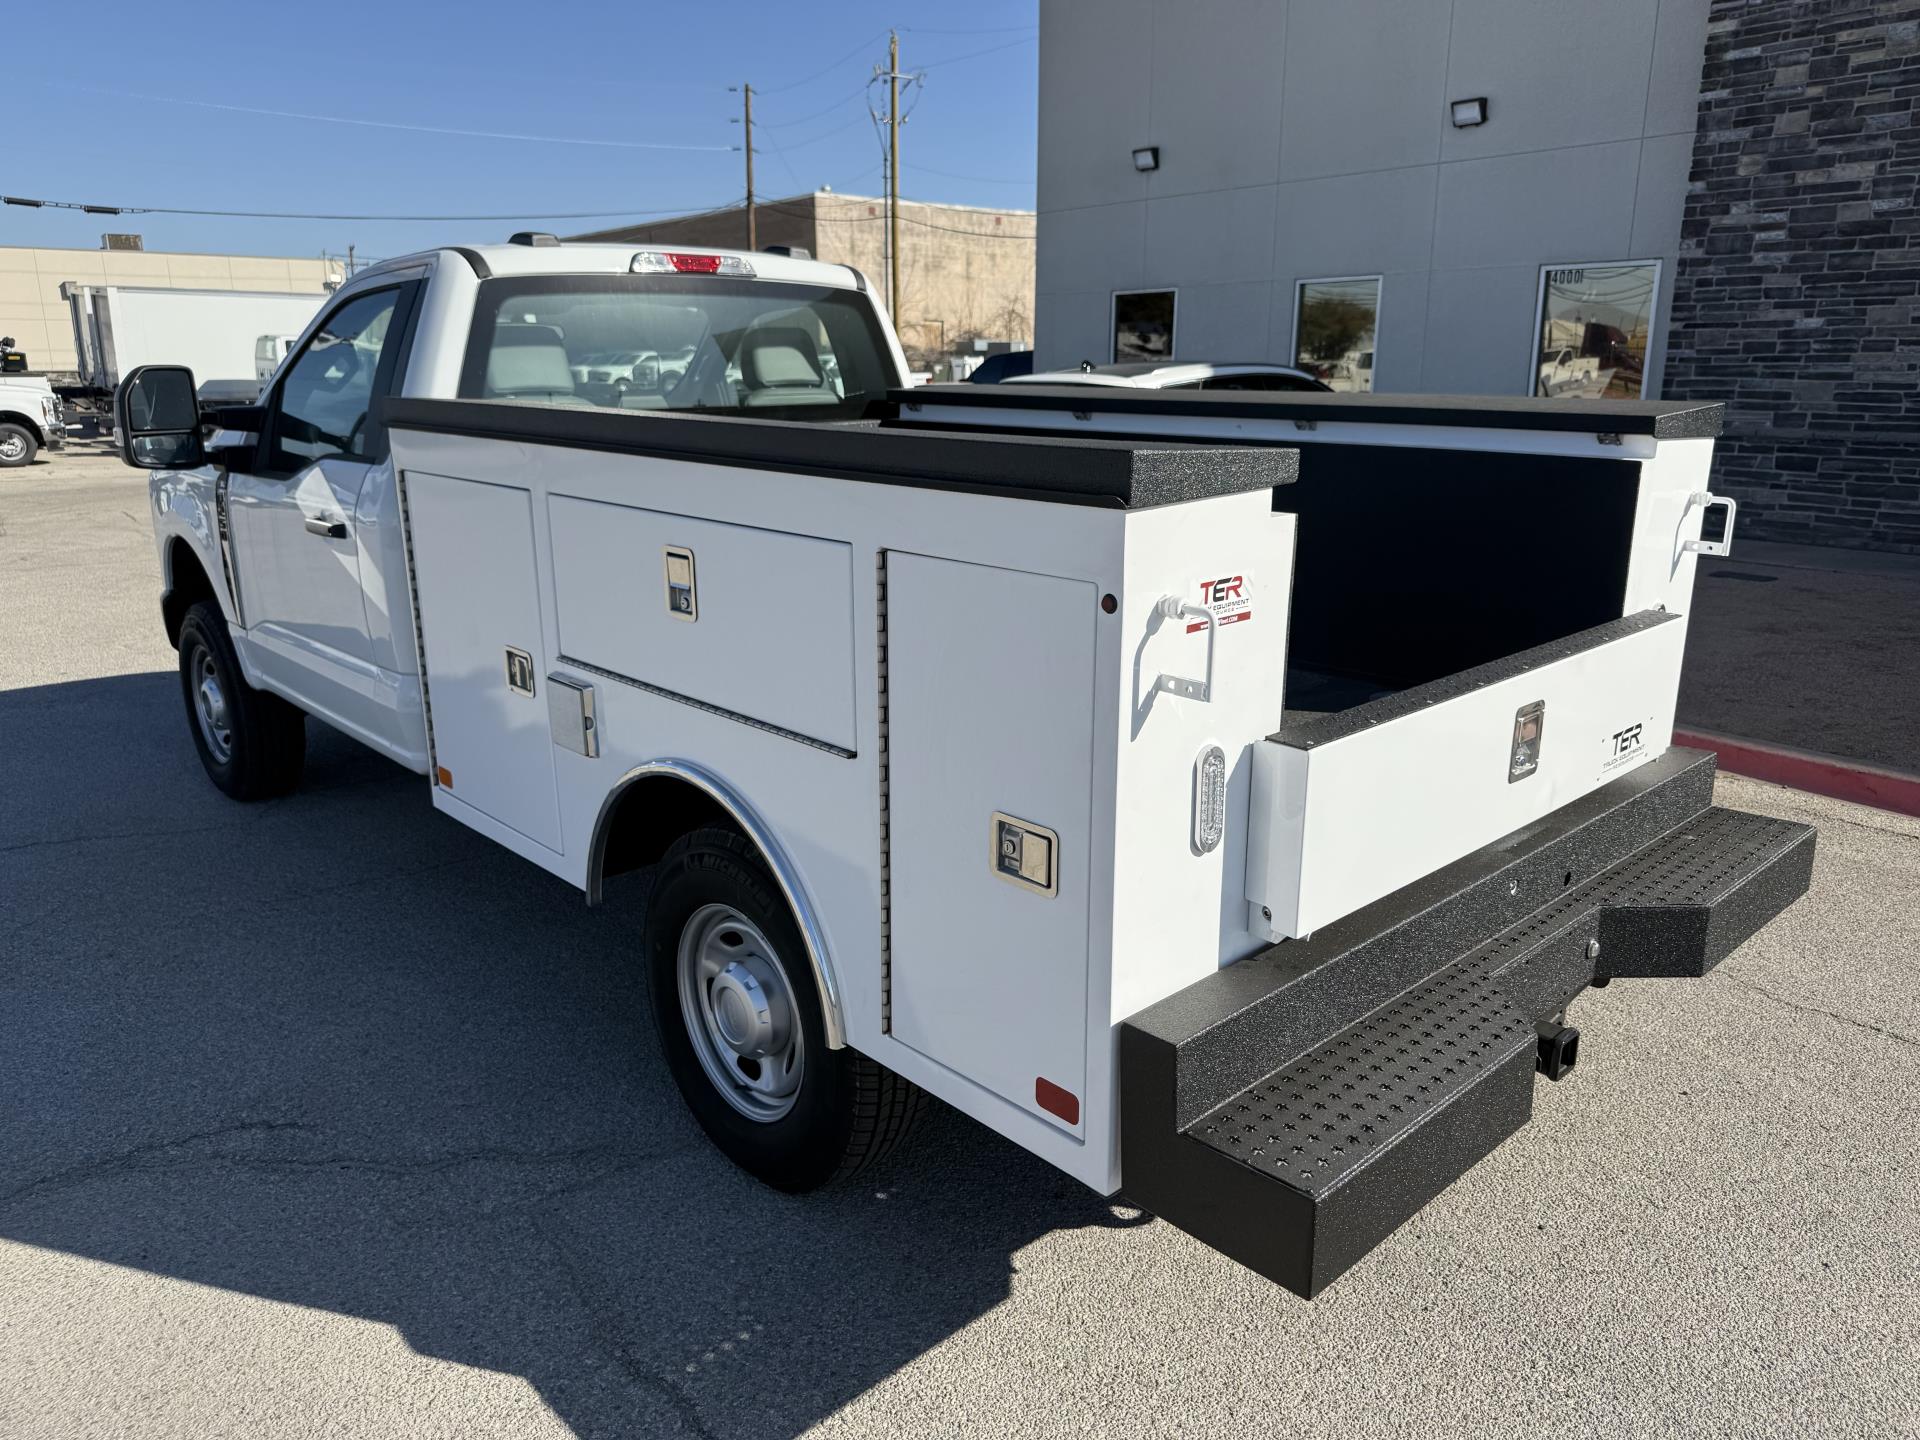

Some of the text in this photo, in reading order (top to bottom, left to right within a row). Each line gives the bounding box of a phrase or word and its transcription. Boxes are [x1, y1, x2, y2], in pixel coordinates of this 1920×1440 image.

[1200, 576, 1242, 604] TER
[1212, 598, 1249, 611] EQUIPMENT
[1613, 723, 1642, 755] TER
